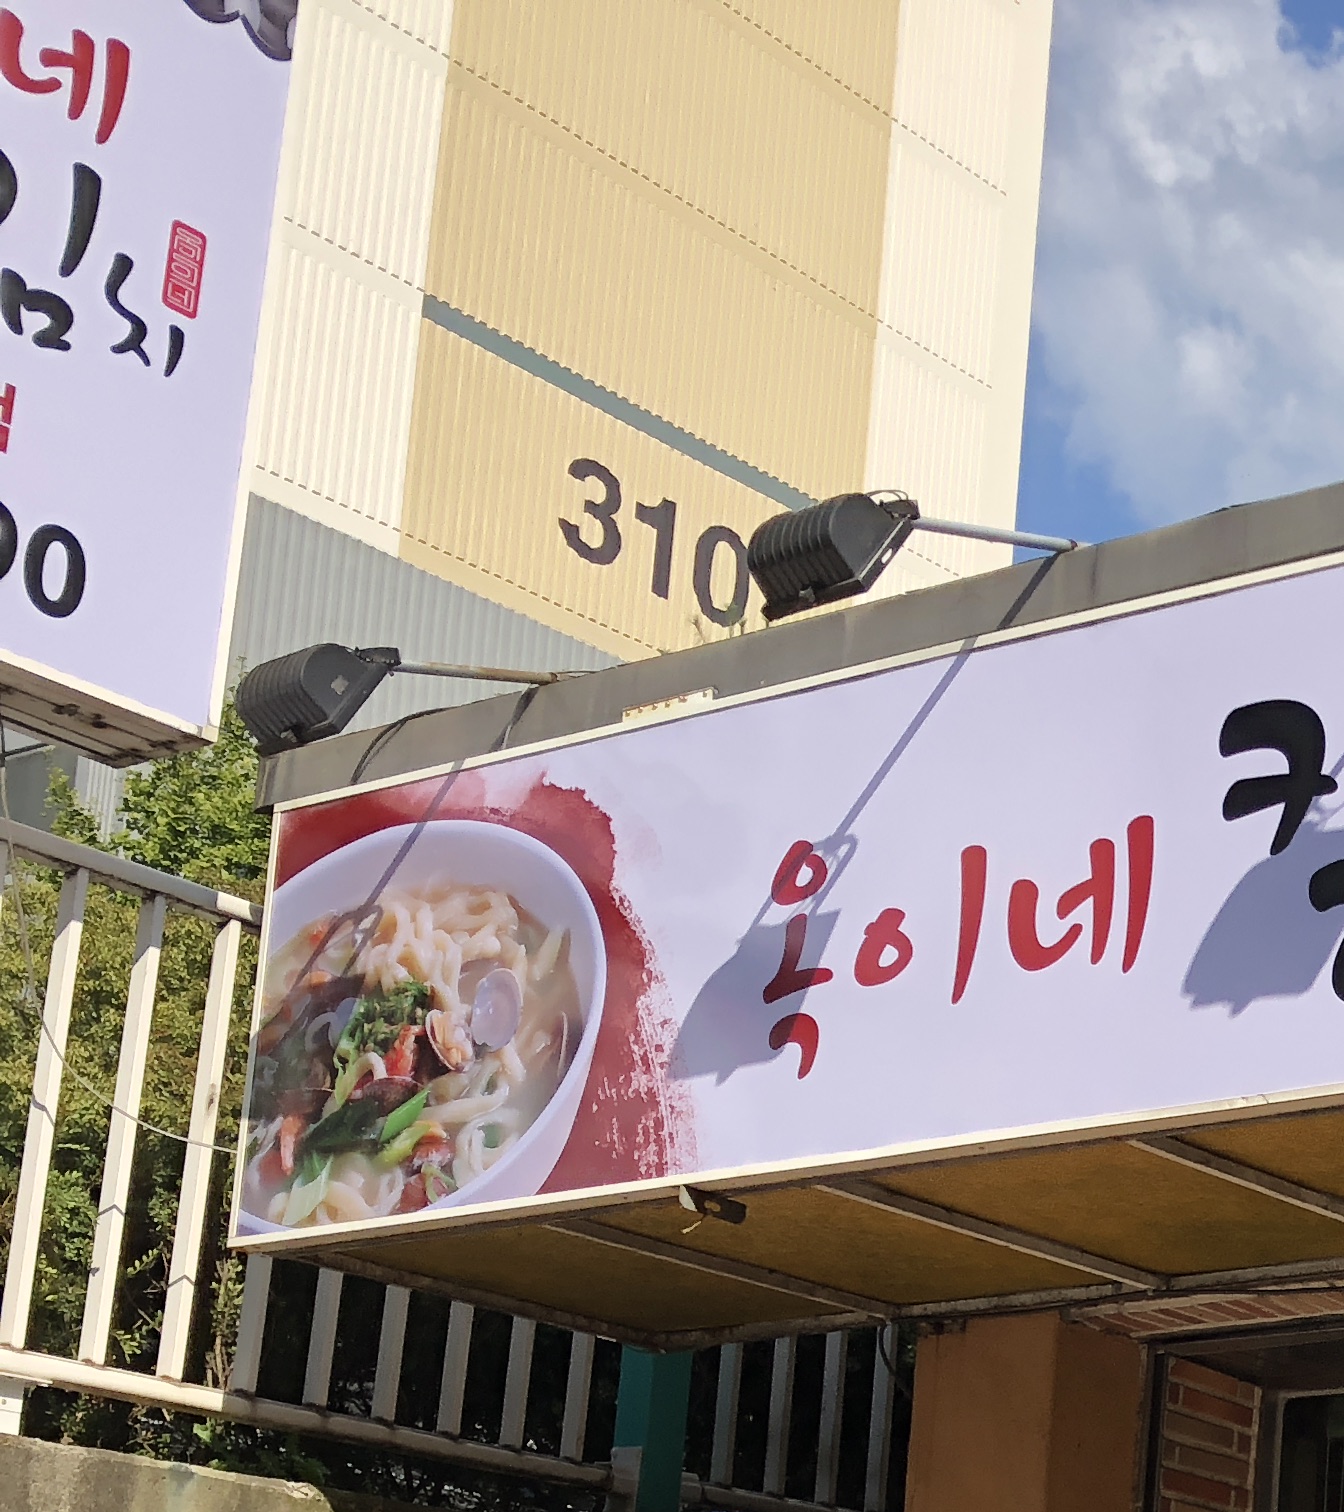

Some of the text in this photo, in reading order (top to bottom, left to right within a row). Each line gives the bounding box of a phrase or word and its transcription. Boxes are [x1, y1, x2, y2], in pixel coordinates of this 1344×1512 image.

[0, 500, 87, 620] 0
[559, 458, 749, 628] 310
[760, 814, 1155, 1080] 옥이네
